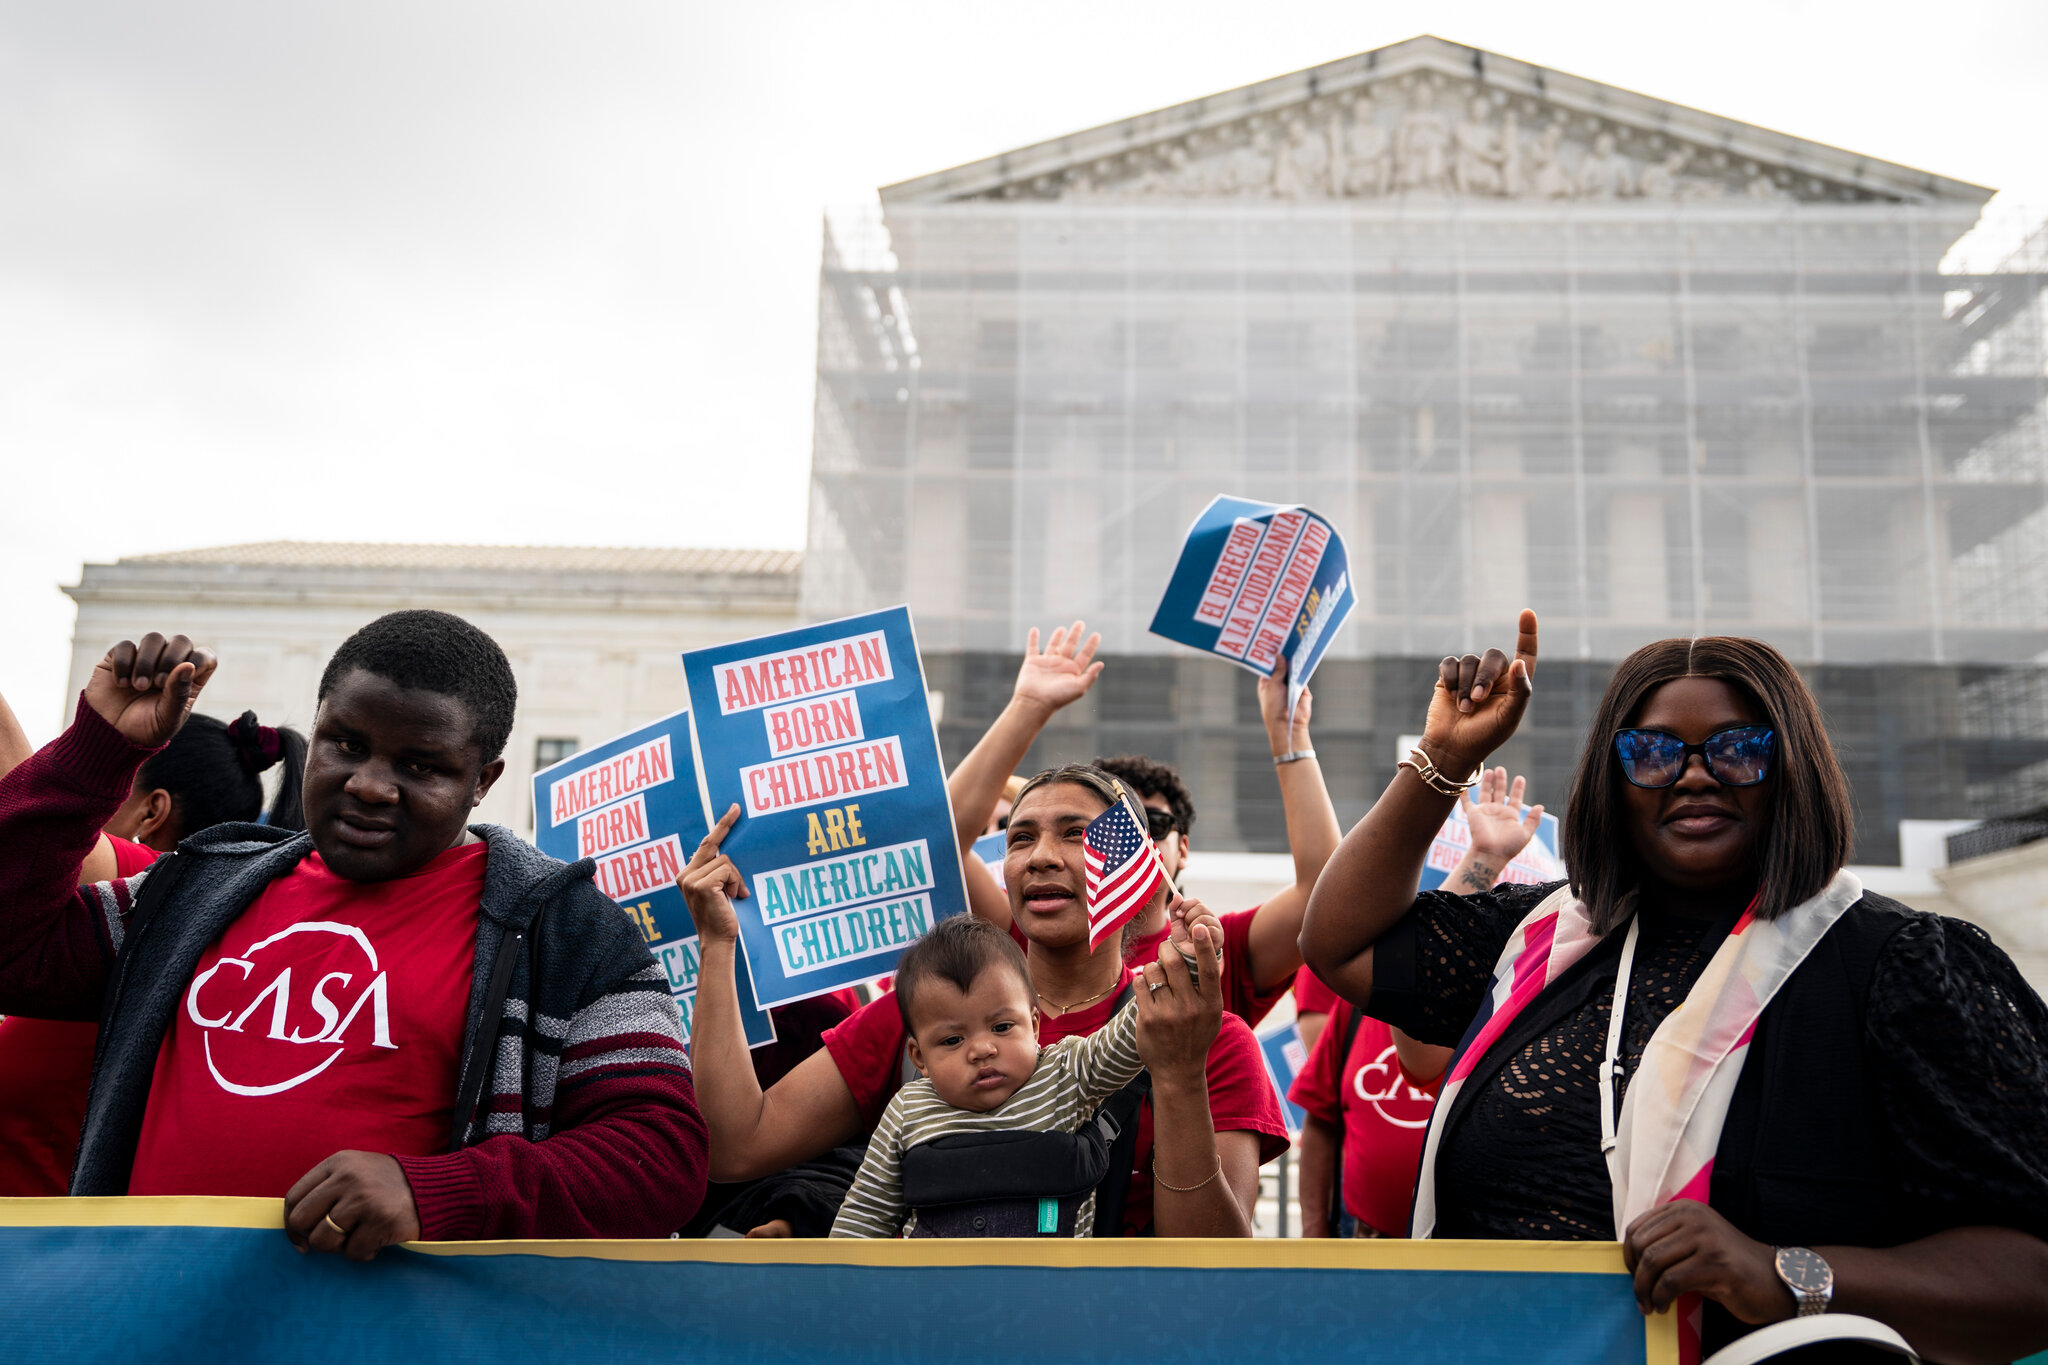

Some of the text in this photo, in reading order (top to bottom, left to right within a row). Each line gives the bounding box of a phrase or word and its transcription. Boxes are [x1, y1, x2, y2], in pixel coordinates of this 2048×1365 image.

[1200, 524, 1260, 620] EL DERECHO
[1266, 523, 1327, 632] NACIMIENTO
[1305, 586, 1321, 619] UN
[1220, 640, 1244, 655] A
[1226, 616, 1255, 639] LA
[1250, 629, 1283, 665] POR
[725, 637, 887, 710] AMERICAN
[771, 697, 858, 753] BORN
[555, 742, 669, 822] AMERICAN
[748, 742, 901, 811] CHILDREN
[582, 800, 645, 857] BORN
[806, 803, 867, 856] ARE
[765, 845, 929, 920] AMERICAN
[781, 897, 929, 971] CHILDREN
[187, 957, 399, 1049] CASA
